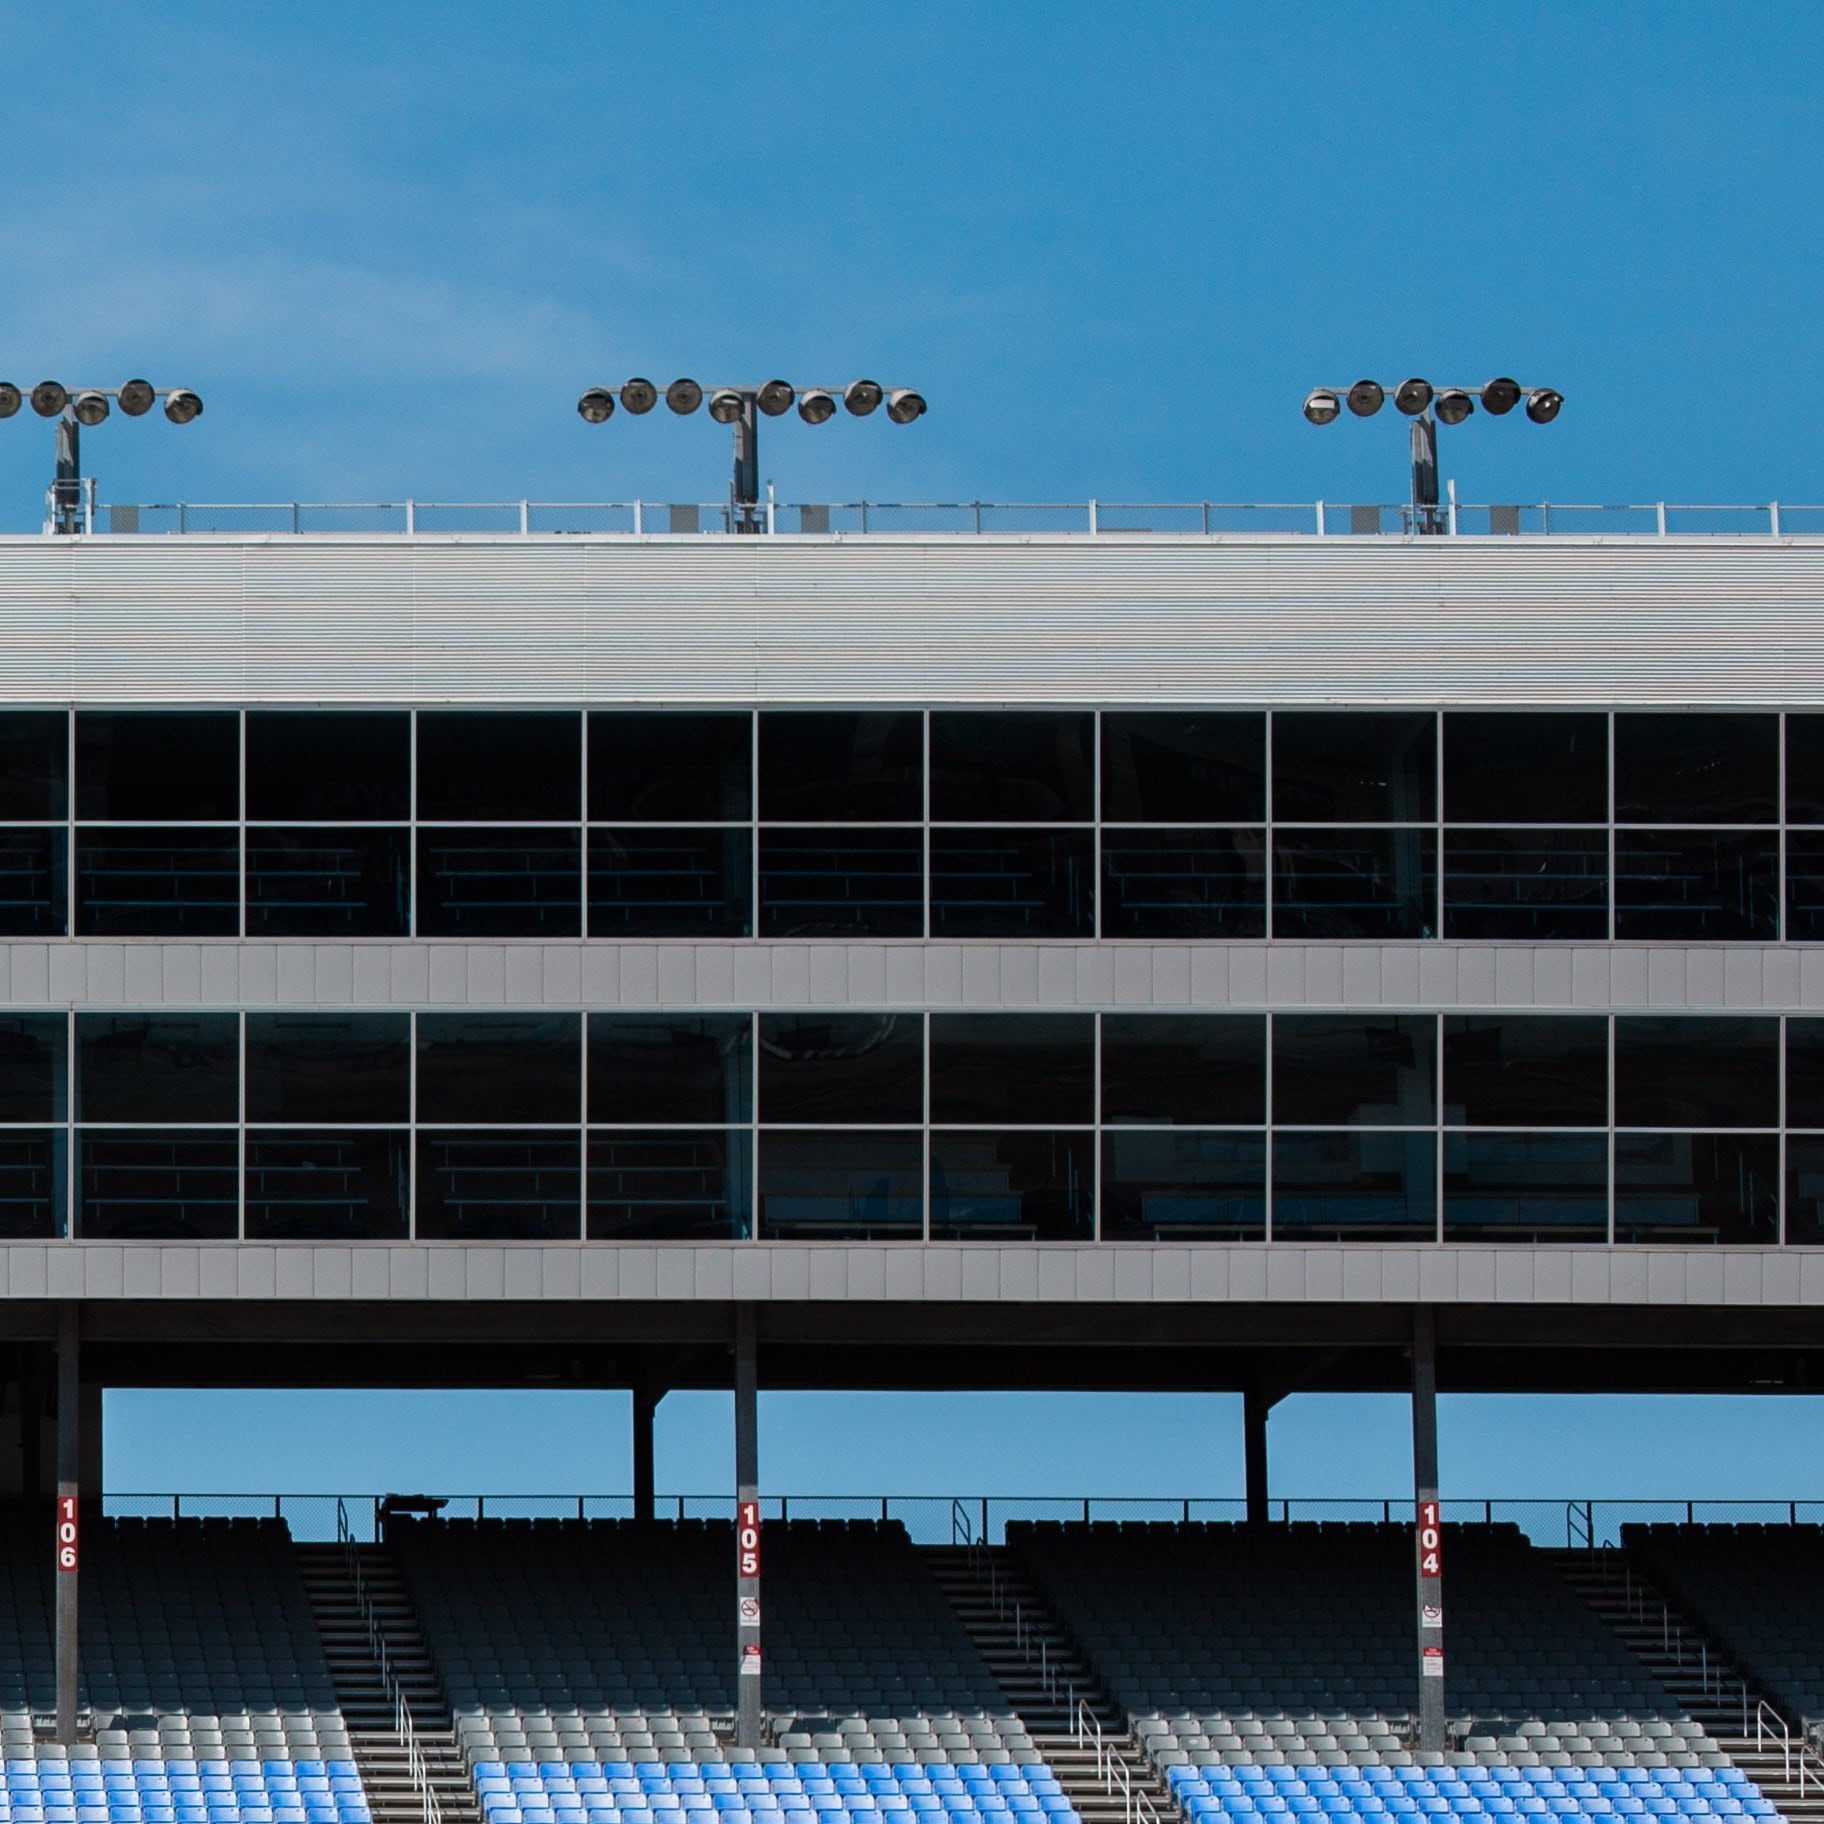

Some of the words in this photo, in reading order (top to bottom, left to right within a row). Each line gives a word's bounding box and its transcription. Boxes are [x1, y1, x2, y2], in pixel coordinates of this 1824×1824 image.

[60, 1498, 76, 1568] 106
[741, 1504, 757, 1574] 105
[1422, 1504, 1439, 1574] 104
